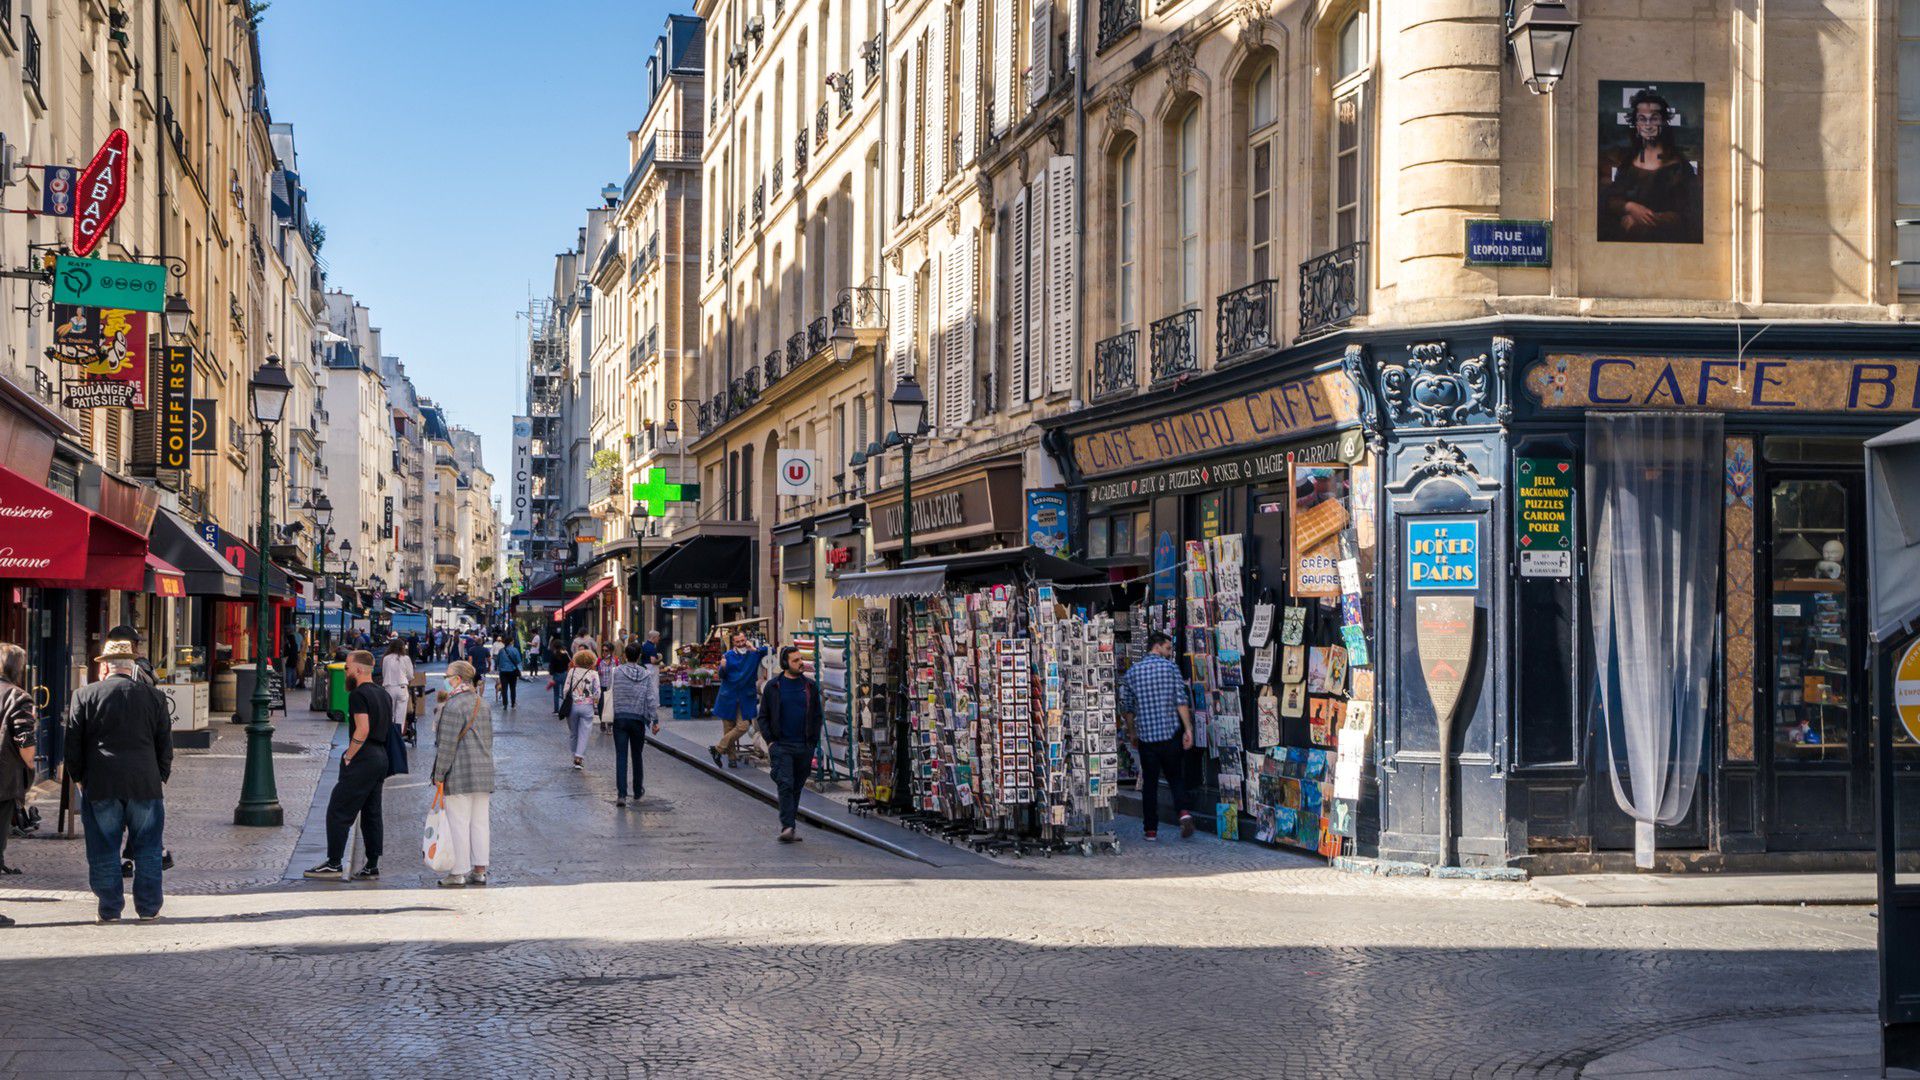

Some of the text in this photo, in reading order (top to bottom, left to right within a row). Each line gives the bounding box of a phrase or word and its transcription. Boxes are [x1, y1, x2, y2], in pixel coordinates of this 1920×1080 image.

[81, 147, 121, 235] TABAC
[1494, 231, 1522, 241] RUE
[1473, 245, 1543, 256] LEOPOLD BELLAN
[1588, 359, 1796, 406] CAFE
[70, 383, 133, 397] BOULANGER
[72, 395, 127, 407] PATISSIER
[1088, 380, 1332, 468] CAFE BIARD CAFE
[789, 466, 804, 480] U
[1098, 481, 1129, 500] CADEAUX
[1139, 476, 1156, 494] JEUX
[1169, 468, 1201, 489] PUZZLES
[1213, 462, 1241, 482] POKER
[1255, 453, 1284, 476] MAGIE
[516, 446, 527, 520] MICHOT
[1534, 476, 1556, 486] JEUX
[1520, 487, 1569, 498] BACKGAMMON
[1525, 499, 1565, 510] PUZZLES
[886, 491, 962, 537] QUIAILLERIE
[1523, 511, 1566, 521] CARROM
[1435, 528, 1448, 538] LE
[1528, 523, 1560, 533] POKER
[1411, 538, 1475, 555] JOKER
[1435, 555, 1449, 565] DE
[1412, 562, 1474, 581] PARIS
